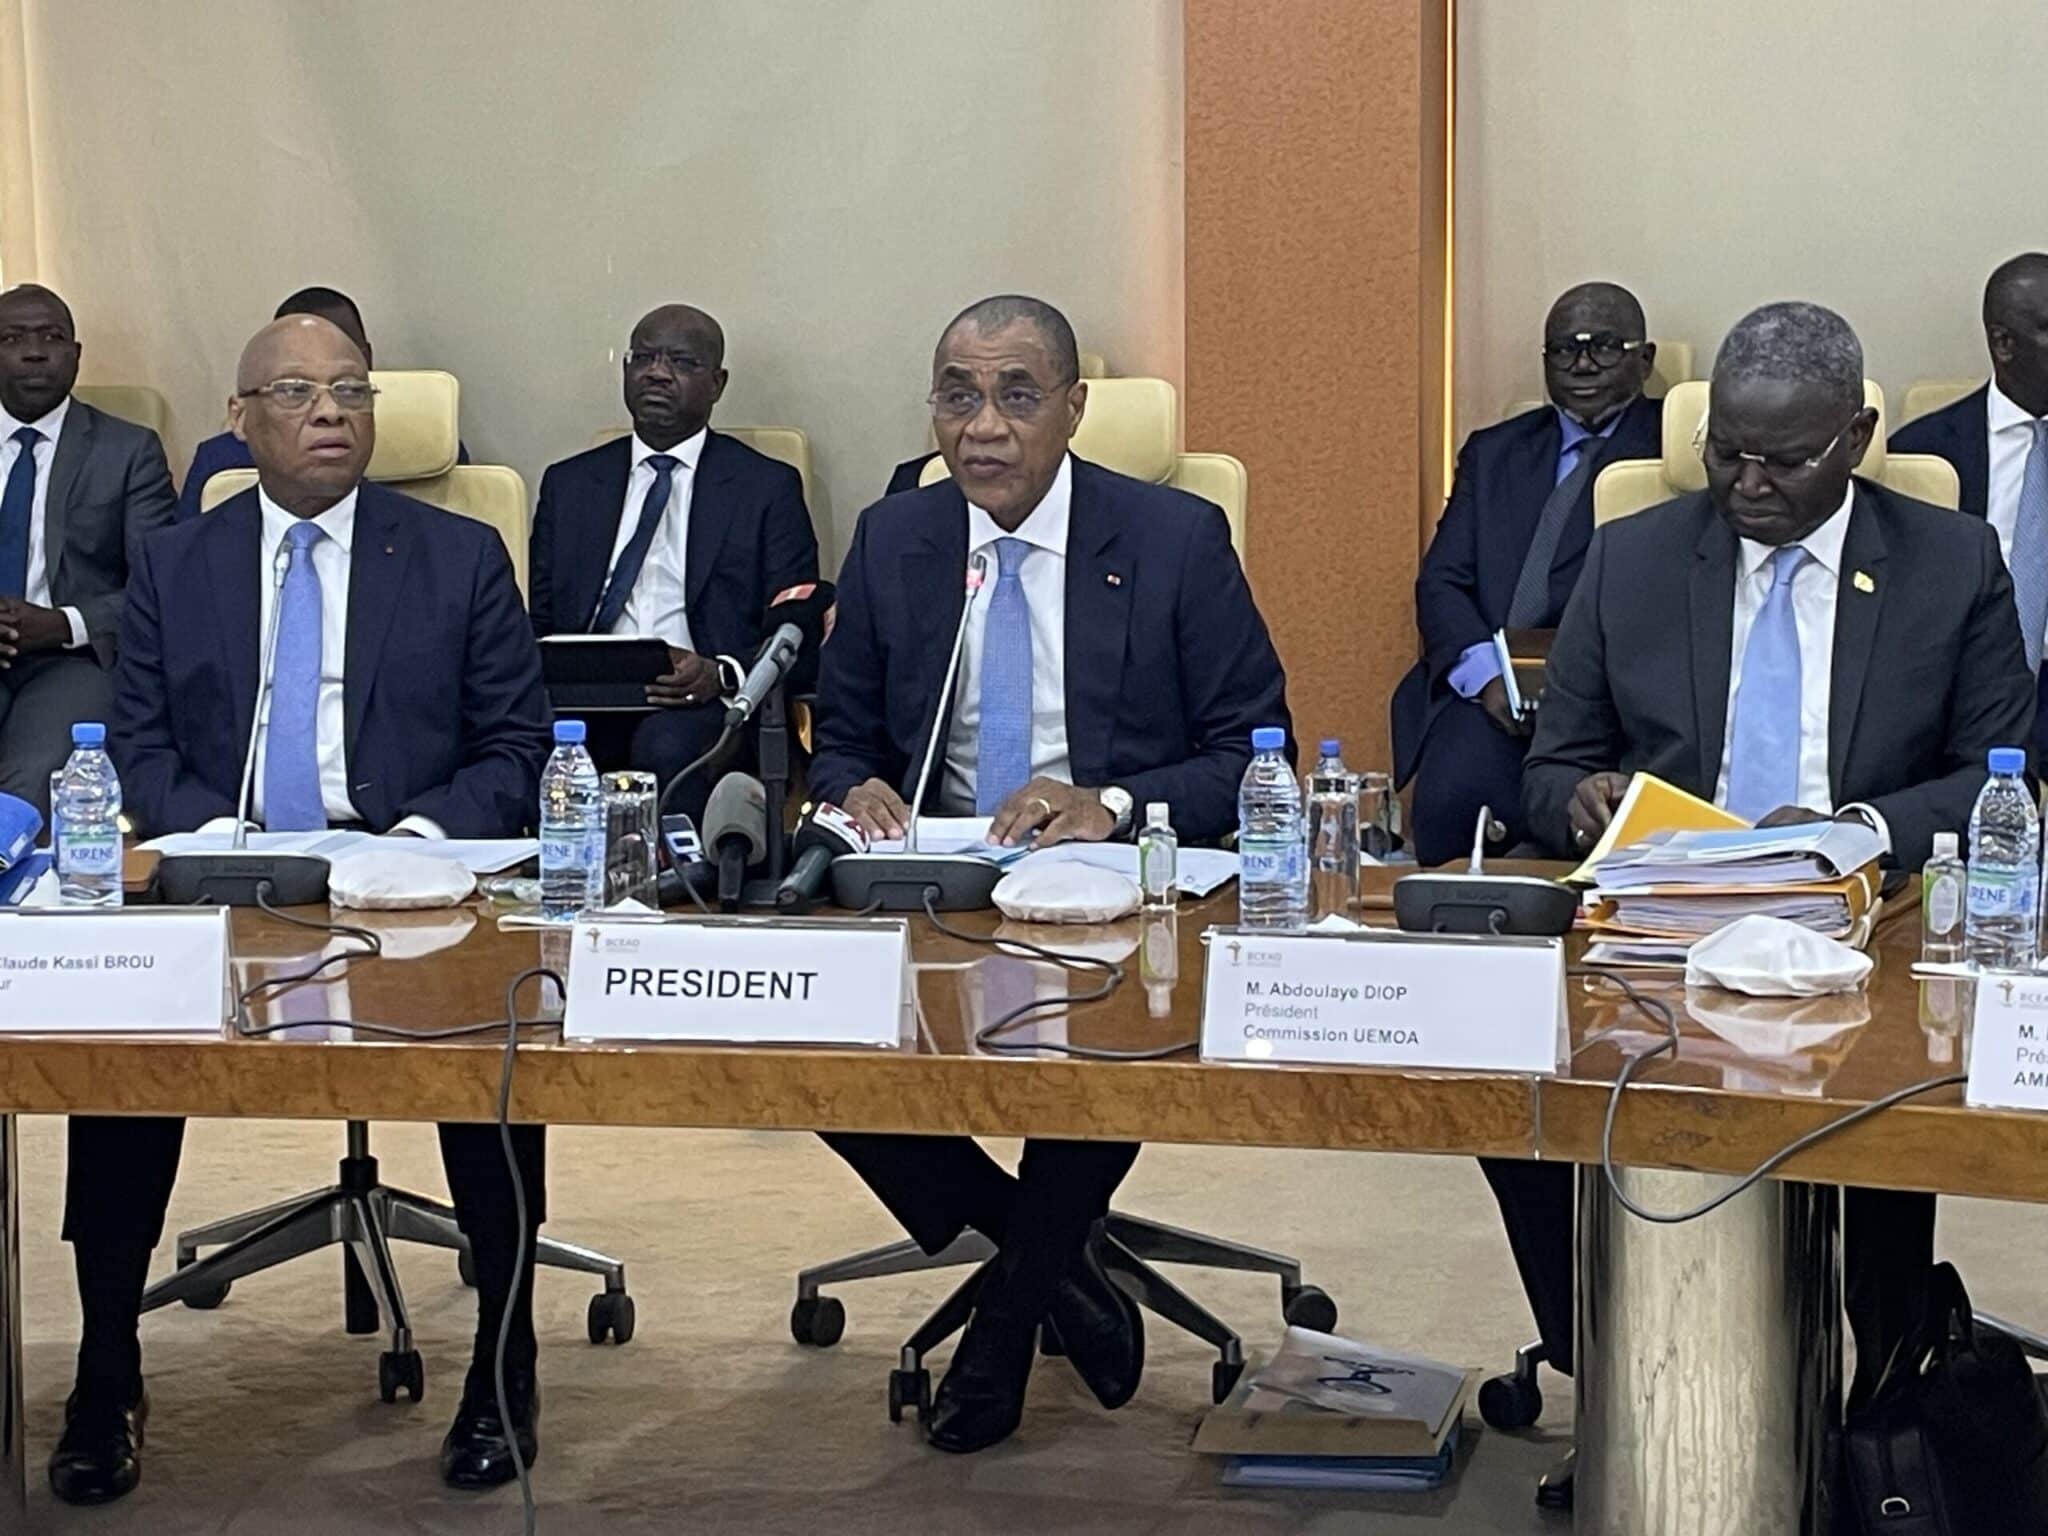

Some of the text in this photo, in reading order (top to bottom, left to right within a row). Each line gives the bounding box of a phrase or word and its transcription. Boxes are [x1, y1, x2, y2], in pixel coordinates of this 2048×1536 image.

[53, 955, 99, 969] Kassi
[104, 955, 155, 969] BROU
[605, 967, 819, 1001] PRESIDENT
[1246, 981, 1408, 1002] M. Abdoulaye DIOP
[1244, 1003, 1319, 1019] Président
[1243, 1024, 1420, 1045] Commission UEMOA
[2018, 1024, 2040, 1041] M.
[2016, 1047, 2048, 1065] Pré
